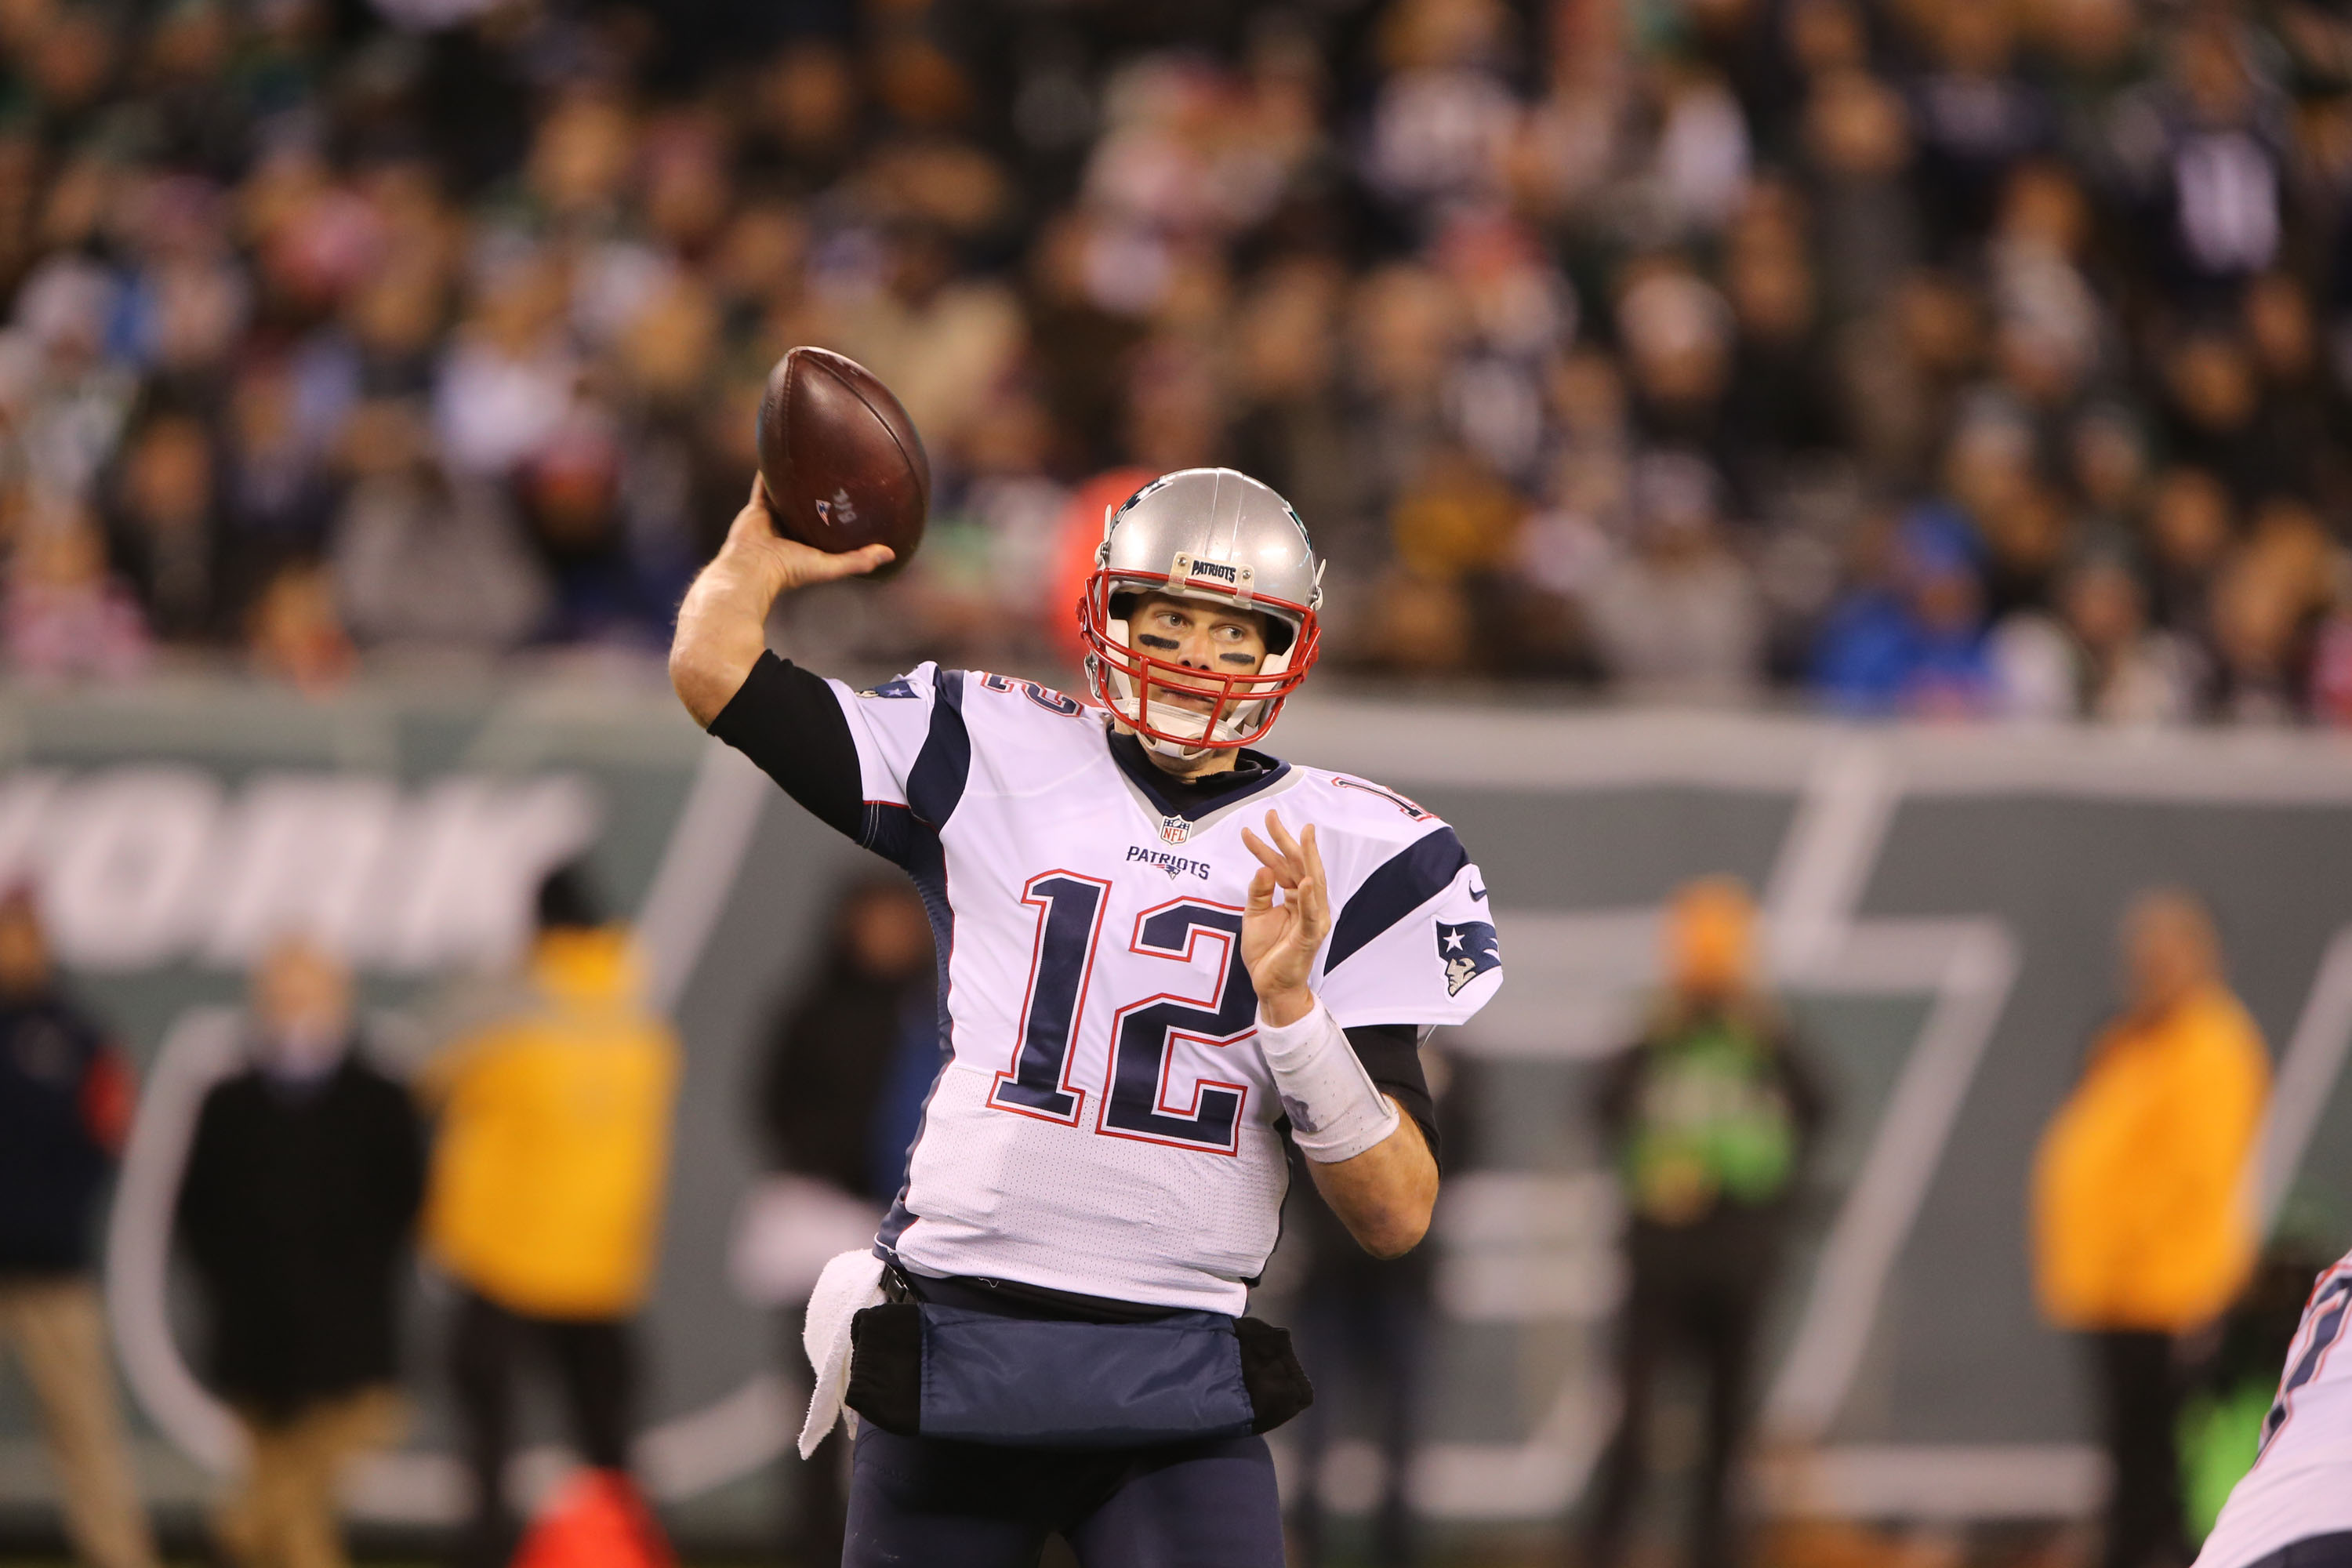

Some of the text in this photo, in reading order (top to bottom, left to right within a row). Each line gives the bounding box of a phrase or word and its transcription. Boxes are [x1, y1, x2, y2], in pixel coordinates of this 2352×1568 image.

[1191, 560, 1236, 583] PATRIOTS
[1163, 827, 1185, 842] NFL
[1126, 845, 1210, 880] PATRIOTS
[985, 868, 1259, 1158] 12
